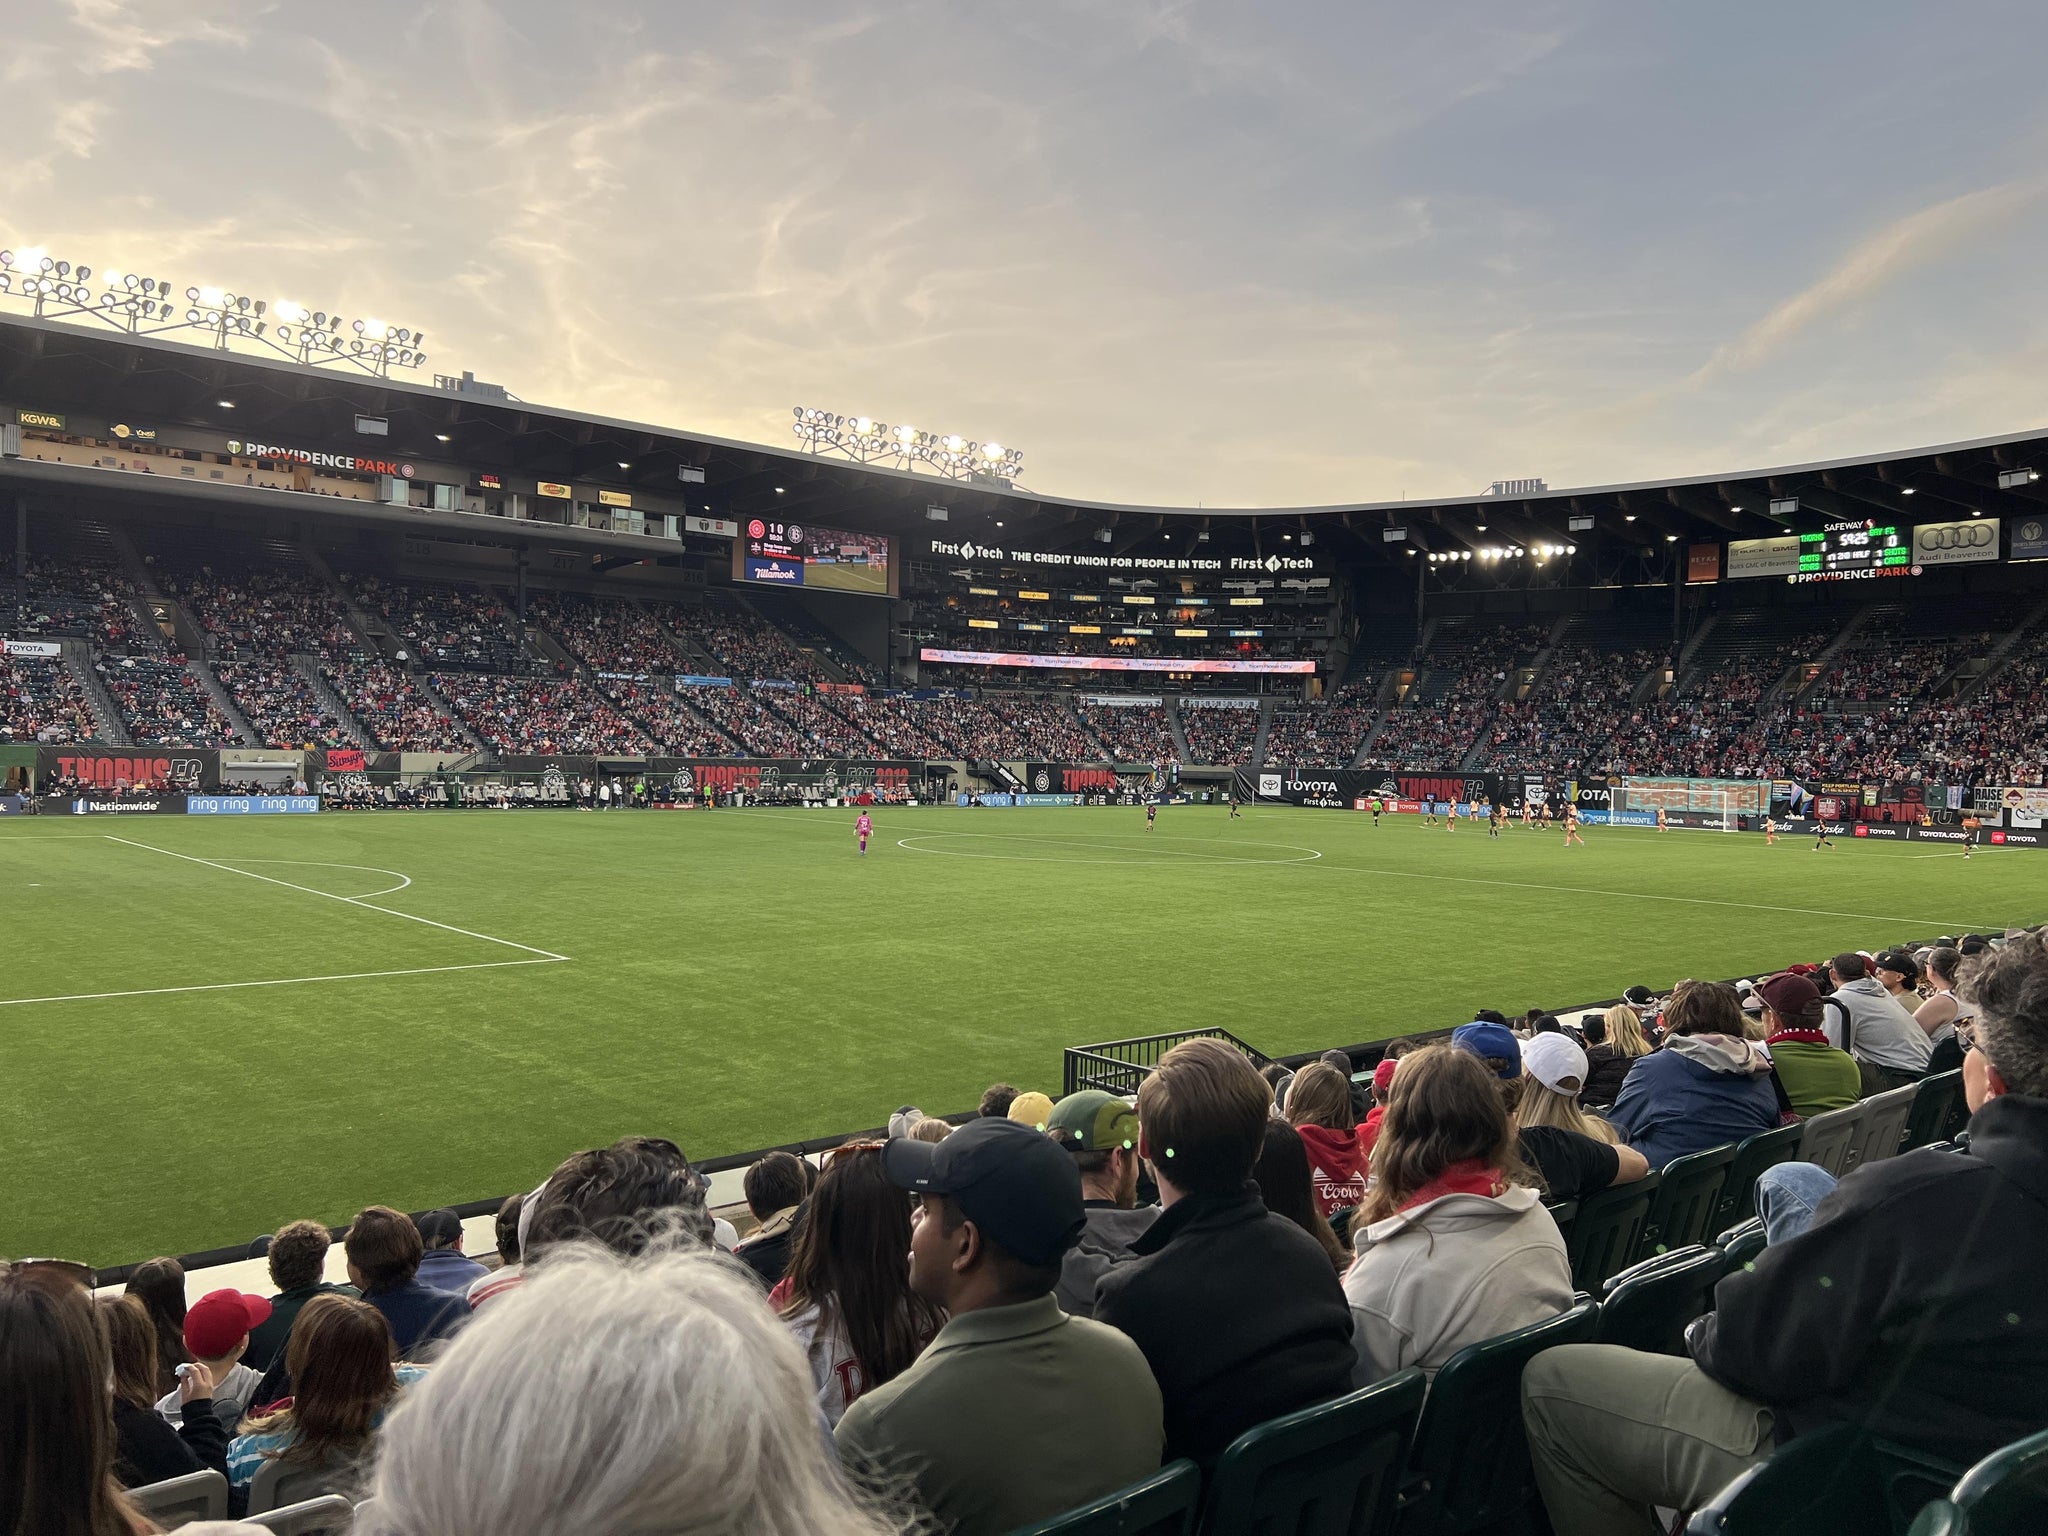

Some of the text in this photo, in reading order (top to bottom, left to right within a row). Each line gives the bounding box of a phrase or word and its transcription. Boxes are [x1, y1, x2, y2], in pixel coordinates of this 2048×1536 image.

[769, 523, 784, 534] 1 0
[1824, 521, 1864, 532] SAFEWAY
[1884, 526, 1896, 535] FC
[1800, 533, 1825, 542] THORNS
[931, 541, 1003, 560] First Tech
[1852, 549, 1871, 559] HALF
[1883, 547, 1906, 556] SHOTS
[1011, 551, 1221, 569] THE CREDIT UNION FOR PEOPLE IN TECH
[1918, 551, 1994, 562] Audi Beaverton
[553, 557, 575, 569] 217
[1231, 557, 1313, 570] First Tech
[1768, 559, 1799, 567] Beaverton
[755, 568, 796, 579] Tillamook
[8, 644, 44, 652] TOYOTA
[57, 757, 170, 789] THORNS
[875, 768, 910, 787] 2012
[694, 766, 760, 796] THORNS
[1285, 780, 1338, 792] TOYOTA
[1399, 778, 1484, 802] THORNS FC
[1975, 788, 2003, 800] RAISE
[90, 801, 158, 811] Nationwide
[191, 798, 250, 813] ring ring
[261, 797, 317, 812] ring ring
[1303, 798, 1343, 807] First Tech
[1975, 801, 2003, 812] THE CAP
[1869, 828, 1896, 836] TOYOTA
[1919, 830, 1967, 839] TOYOTA.COM
[2006, 835, 2037, 843] TOYOTA
[1320, 1183, 1360, 1200] Coors
